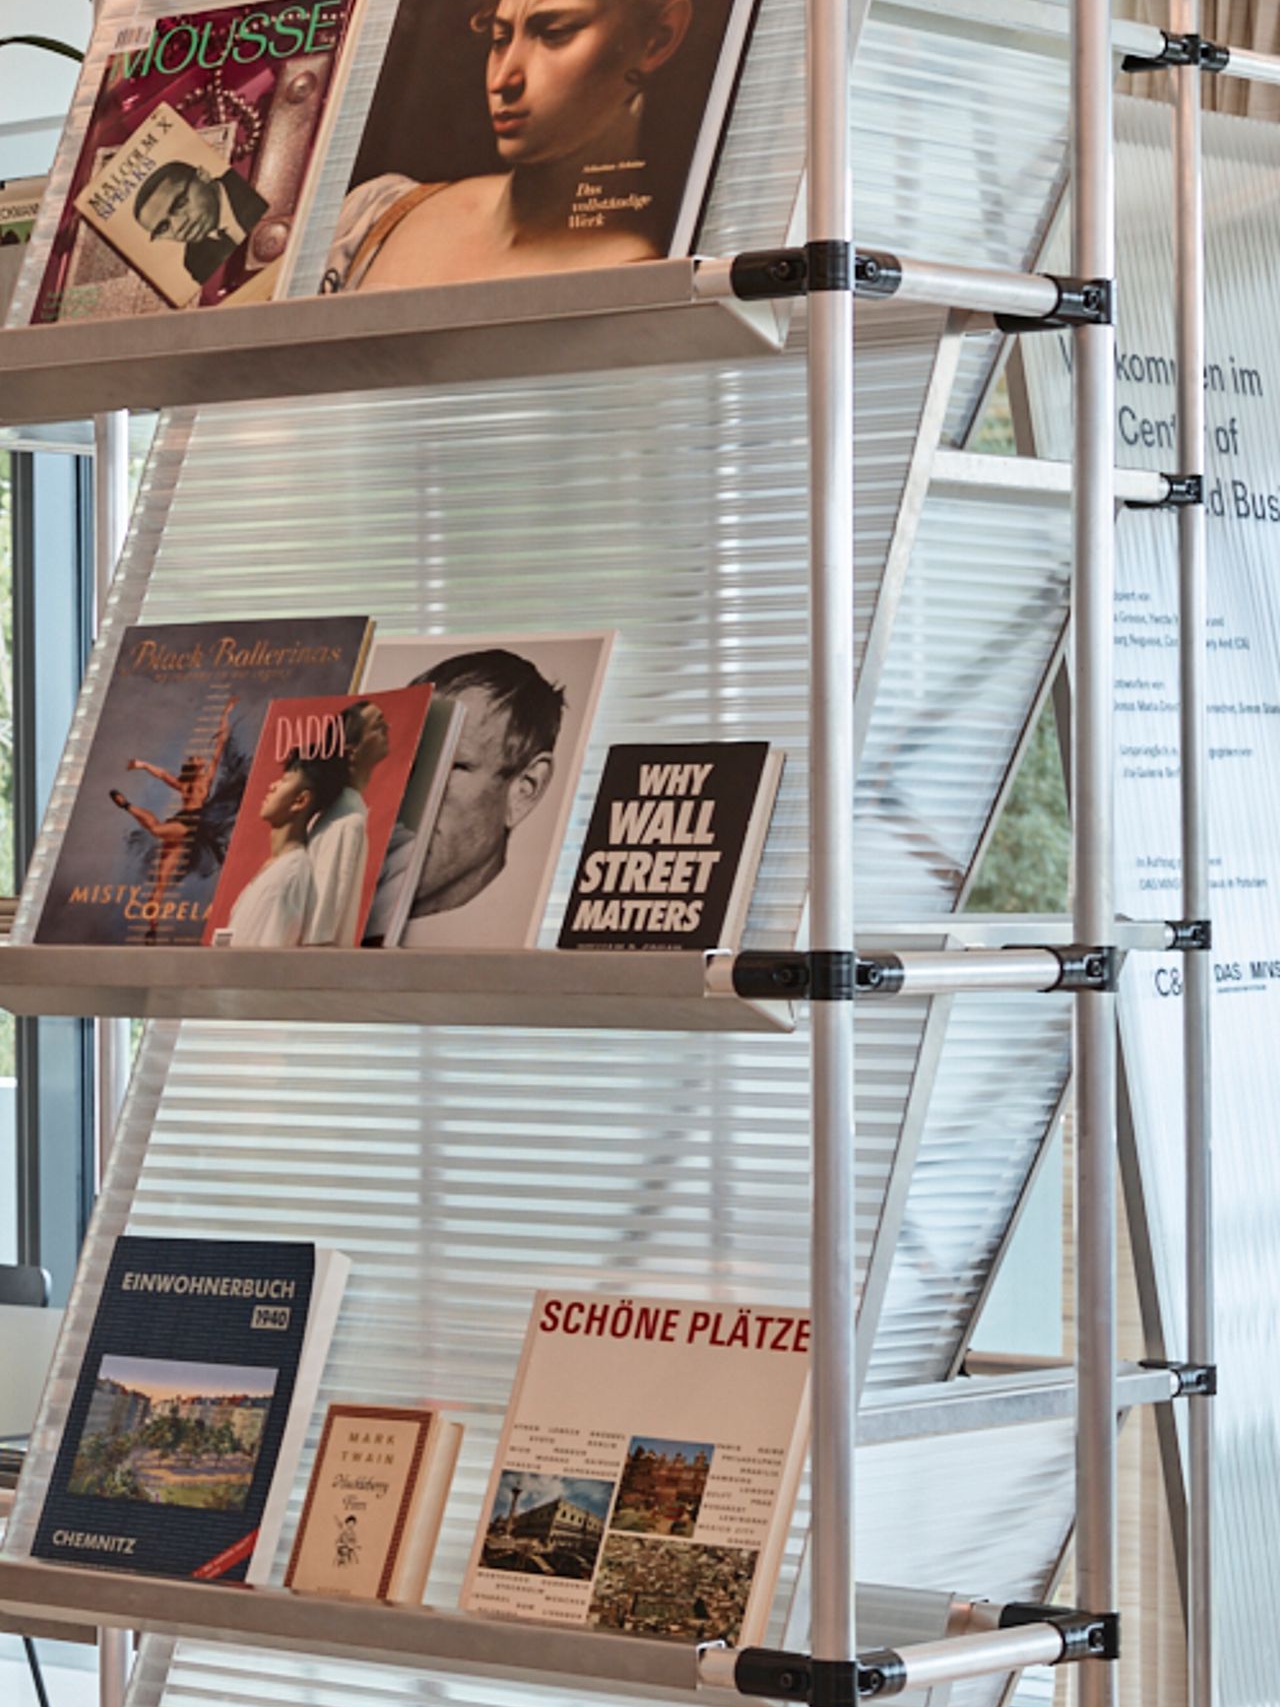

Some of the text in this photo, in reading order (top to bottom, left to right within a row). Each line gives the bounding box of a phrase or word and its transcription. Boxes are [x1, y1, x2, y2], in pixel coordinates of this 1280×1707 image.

[109, 0, 342, 81] MOUSSE
[1229, 355, 1264, 397] im
[1118, 405, 1239, 455] Cent of
[1232, 479, 1280, 523] Bus
[132, 636, 342, 671] Black Ballerinas
[275, 714, 346, 762] DADDY
[639, 764, 714, 796] WHY
[608, 800, 716, 845] WALL
[577, 851, 722, 893] STREET
[68, 883, 142, 905] MISTY
[571, 899, 705, 933] MATTERS
[1214, 962, 1243, 983] DAS
[122, 1271, 297, 1300] EINWOHNERBUCH
[255, 1307, 289, 1327] 1940
[539, 1299, 812, 1353] SCHÖNE PLÄTZE
[348, 1430, 396, 1445] MARK
[341, 1450, 395, 1465] TWAIN
[51, 1528, 138, 1555] CHEMNITZ
